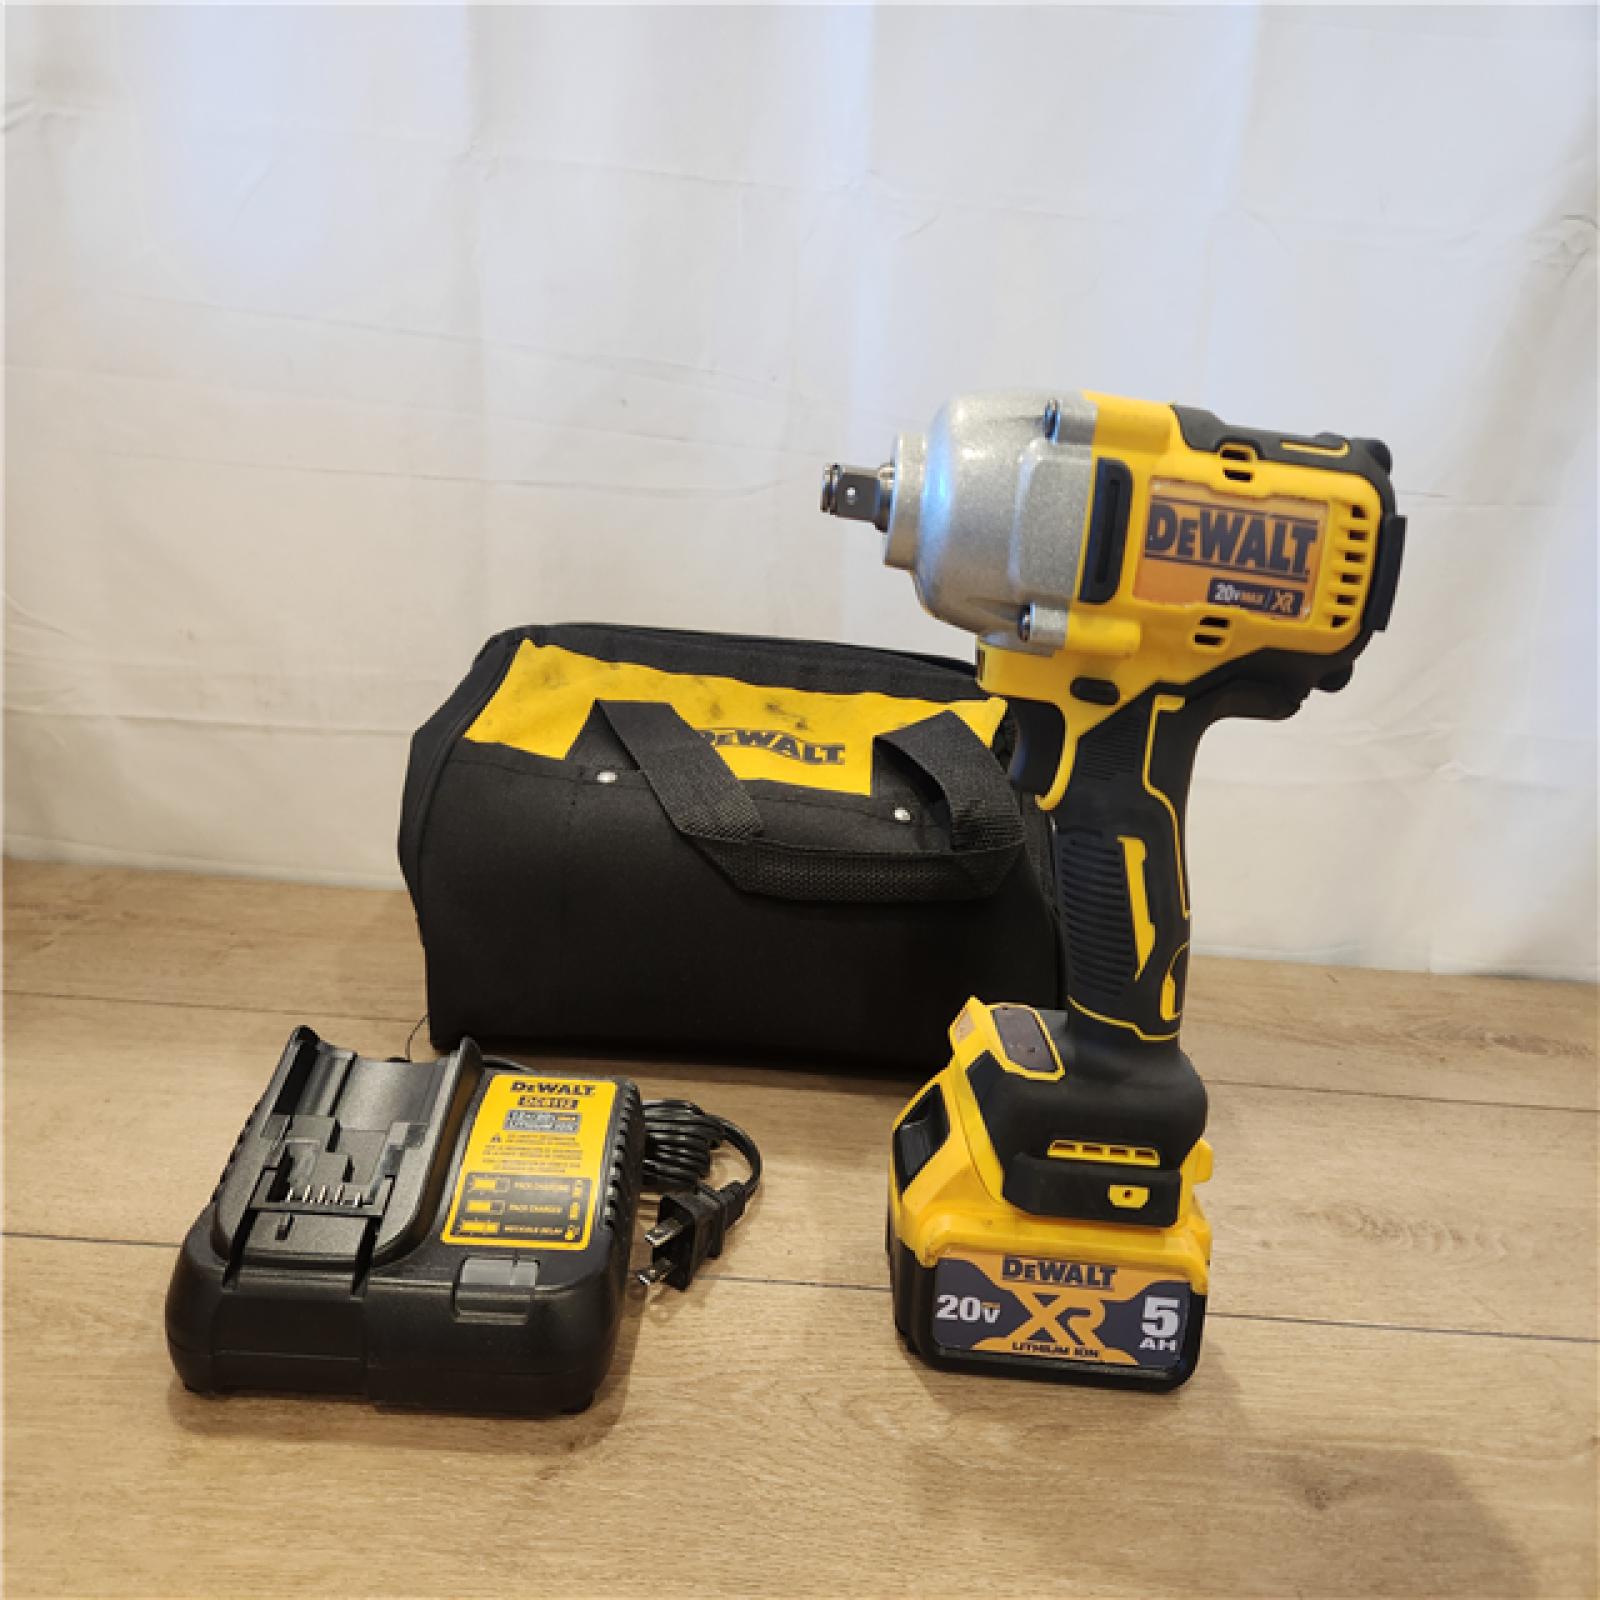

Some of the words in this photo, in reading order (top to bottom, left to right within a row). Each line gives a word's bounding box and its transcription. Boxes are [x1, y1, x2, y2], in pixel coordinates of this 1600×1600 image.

[1145, 505, 1319, 575] DEWALT
[1002, 1255, 1117, 1287] DEWALT
[1008, 1292, 1106, 1347] XR
[1140, 1296, 1180, 1338] 5
